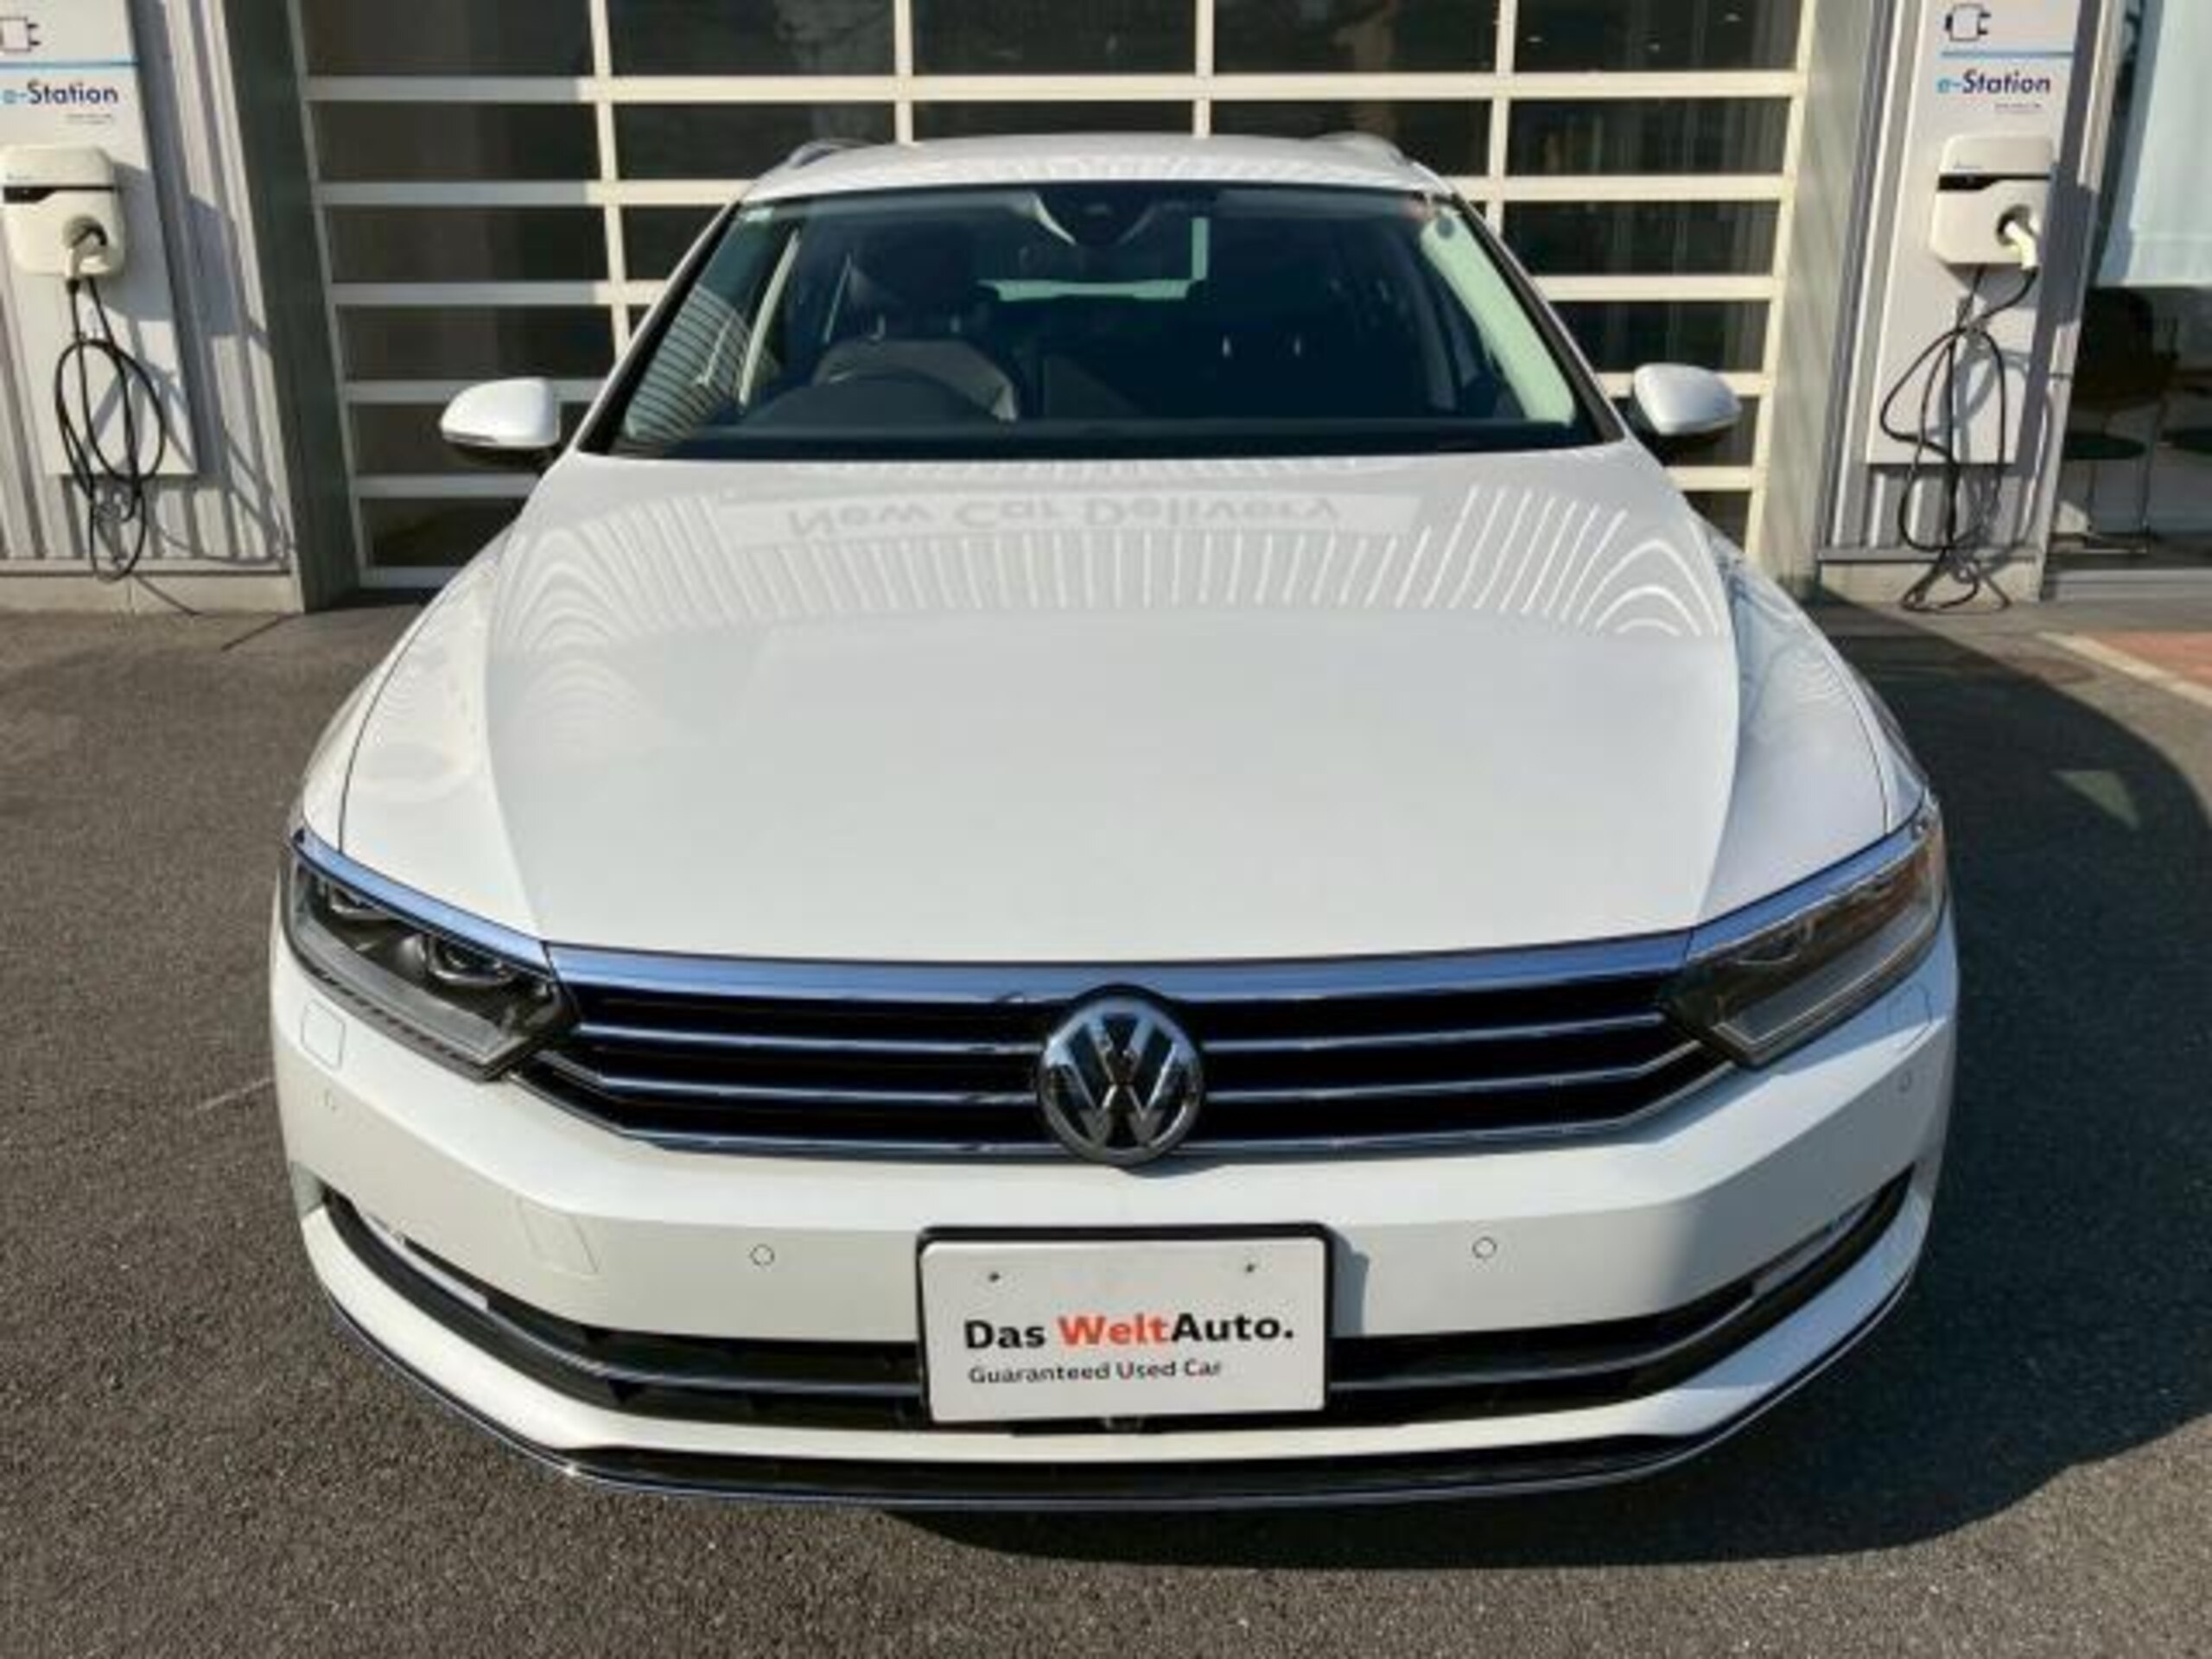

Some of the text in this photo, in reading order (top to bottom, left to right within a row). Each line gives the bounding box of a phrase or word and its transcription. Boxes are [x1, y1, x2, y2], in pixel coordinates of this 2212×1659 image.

[2, 79, 118, 104] e-Station
[1936, 68, 2050, 93] e-Station
[964, 1313, 1294, 1349] Das WeltAuto.
[969, 1357, 1222, 1383] Guaranteed Used Car
